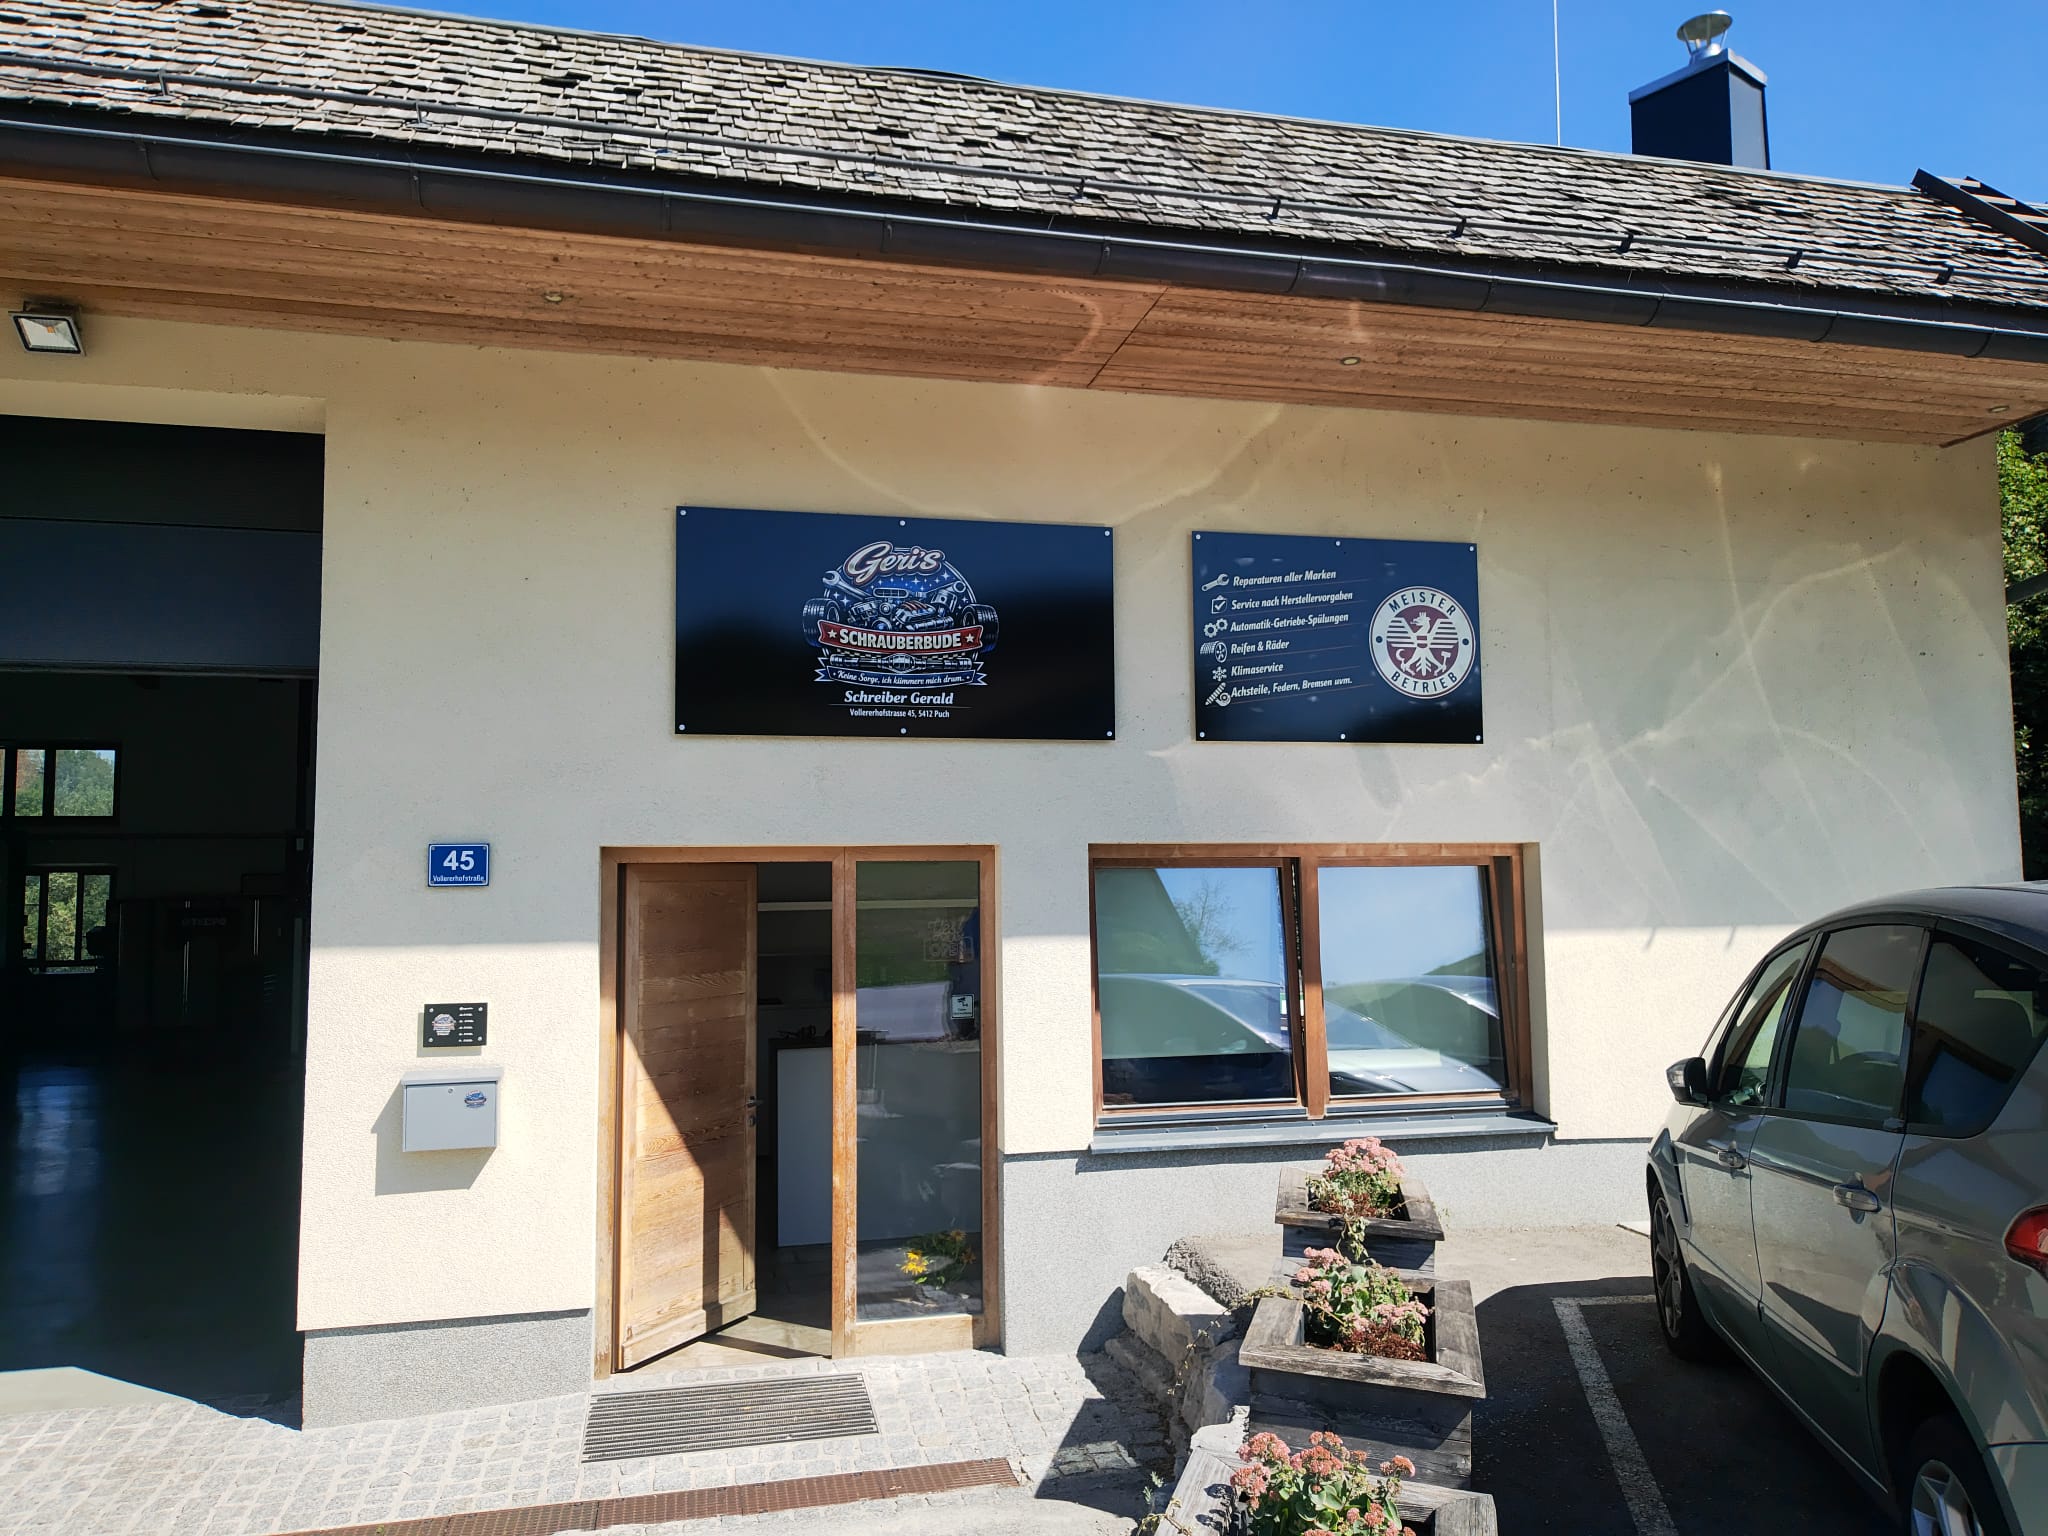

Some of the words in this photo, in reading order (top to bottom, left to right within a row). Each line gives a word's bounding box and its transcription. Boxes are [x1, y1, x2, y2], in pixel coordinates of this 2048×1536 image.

[847, 542, 941, 583] Geri's
[1233, 574, 1282, 588] Reparaturen
[1284, 572, 1302, 583] aller
[1304, 569, 1337, 581] Marken
[1231, 598, 1260, 610] Service
[1261, 596, 1280, 607] nach
[1281, 591, 1353, 606] Herstellervorgaben
[1388, 591, 1456, 616] MEISTER
[1230, 613, 1349, 632] Automatik-Getriebe-Spülungen
[839, 628, 962, 650] SCHRAUBERBUDE
[1231, 642, 1256, 655] Reifen
[1257, 641, 1264, 651] &
[1265, 638, 1290, 650] Räder
[837, 670, 858, 681] Keine
[858, 672, 880, 685] Sorge,
[881, 674, 892, 684] ich
[893, 673, 924, 686] kümmere
[925, 674, 942, 685] mich
[943, 672, 965, 683] drum.
[1231, 662, 1284, 677] Klimaservice
[1231, 684, 1271, 698] Achsteile,
[1272, 679, 1301, 693] Federn,
[1302, 678, 1333, 690] Bremsen
[1334, 677, 1353, 686] uvm.
[1391, 671, 1458, 693] BETRIEB
[844, 690, 907, 705] Schreiber
[910, 691, 954, 705] Gerald
[849, 708, 907, 718] Vollererhofstrasse
[907, 709, 918, 719] 45,
[918, 709, 933, 718] 5412
[934, 709, 950, 719] Puch
[443, 850, 475, 871] 45
